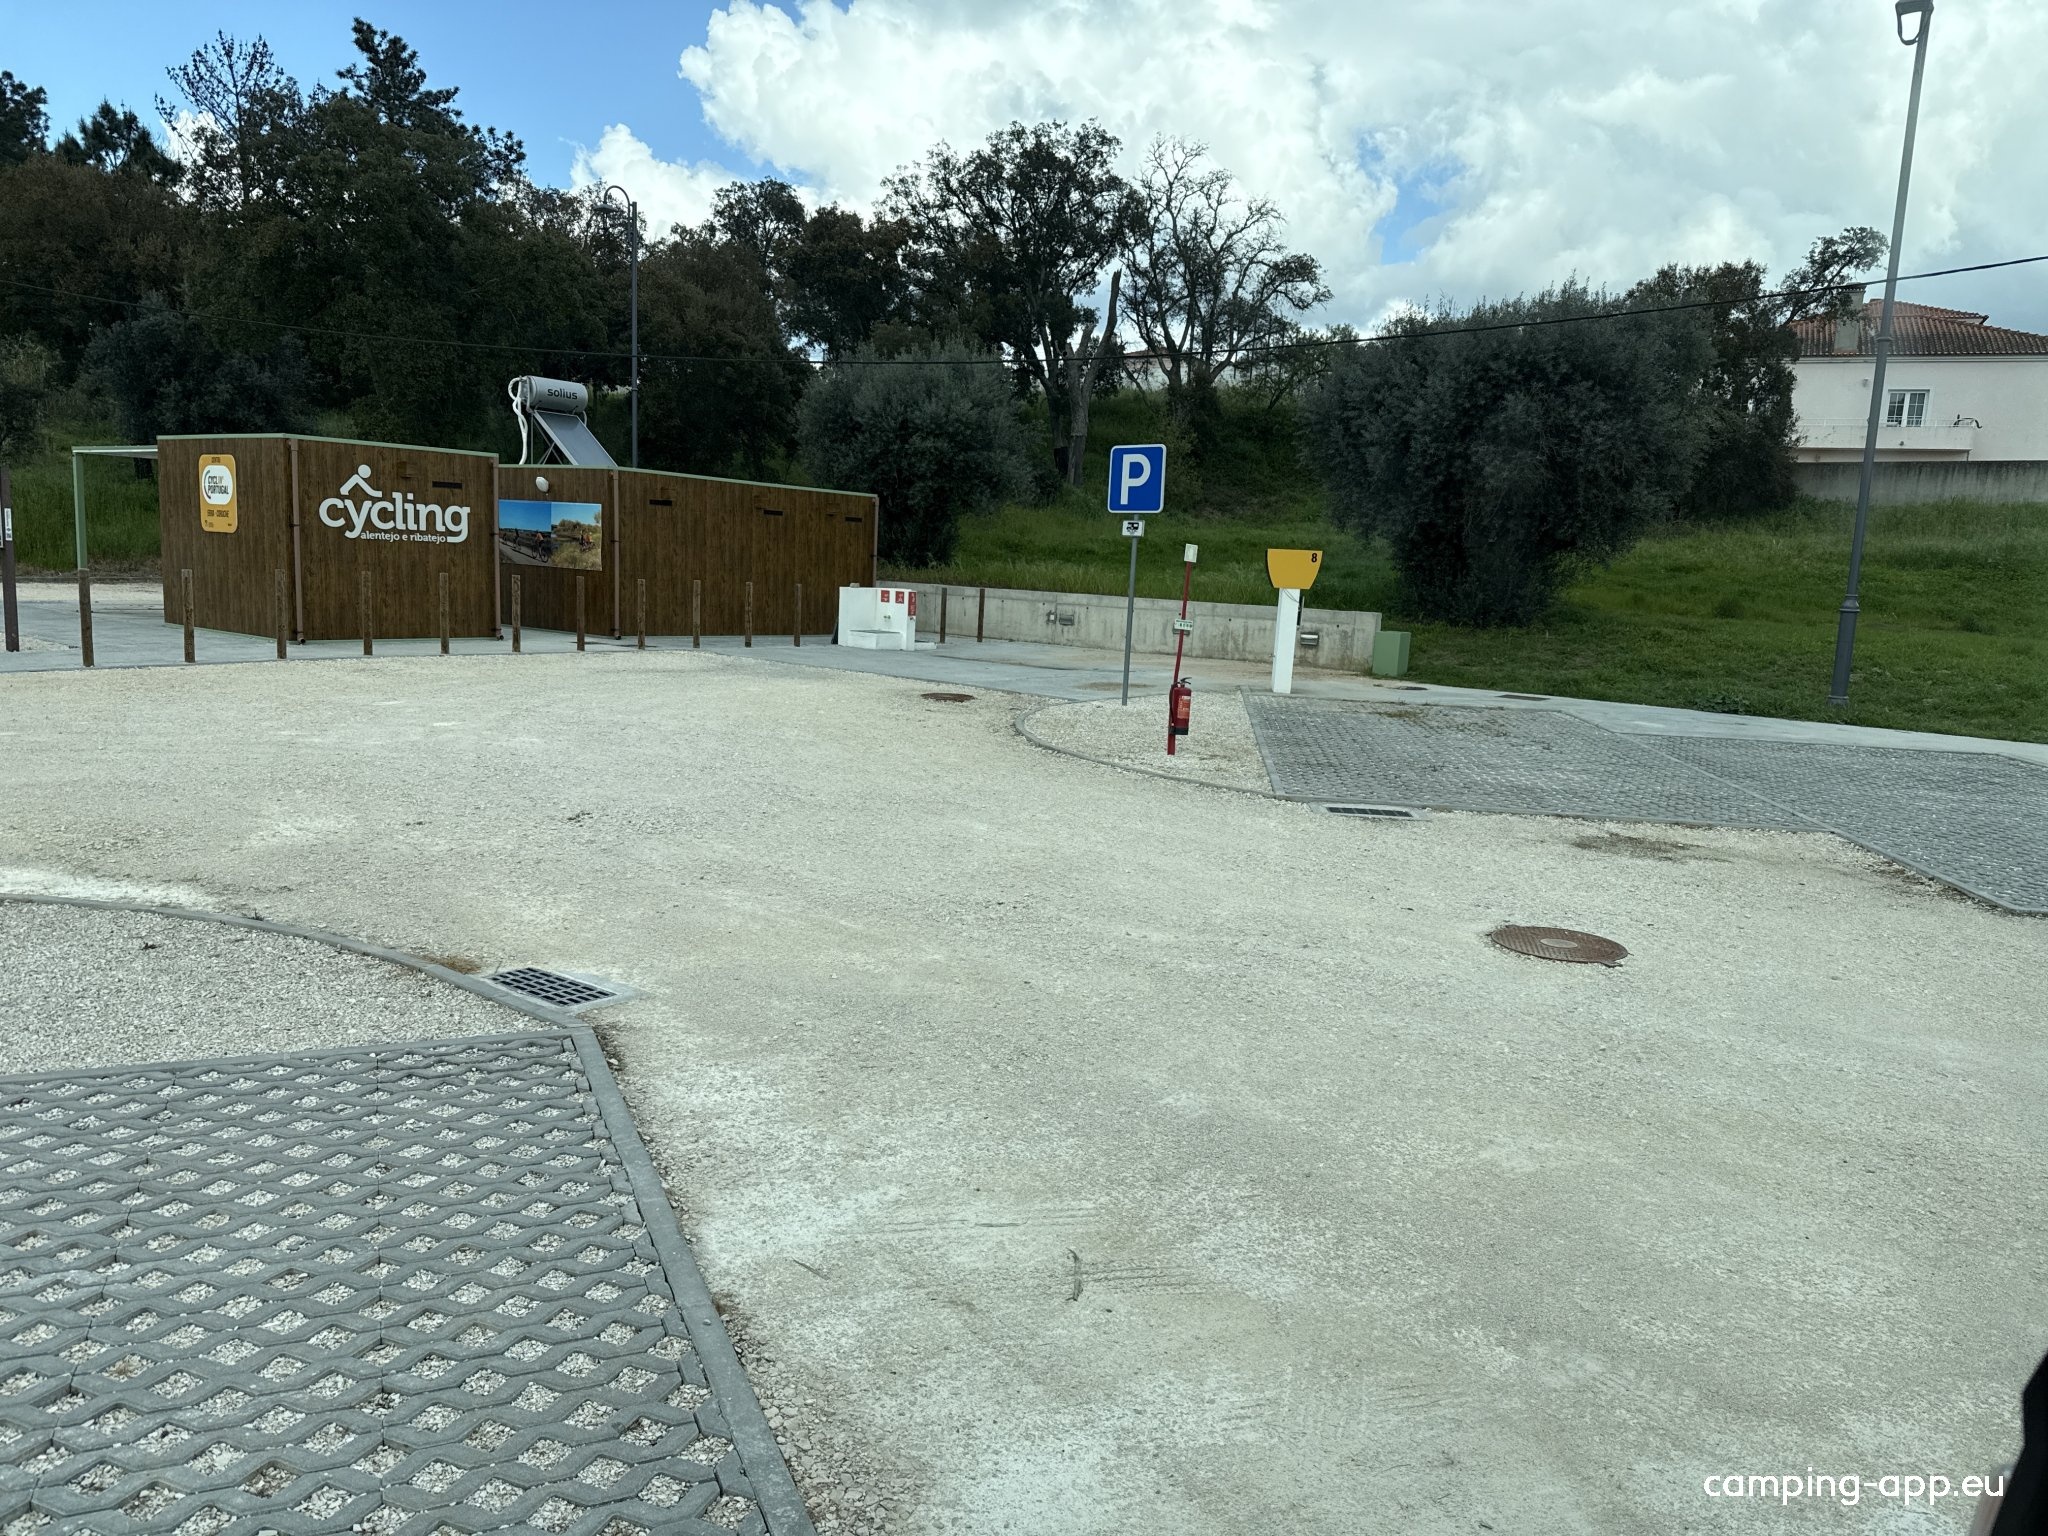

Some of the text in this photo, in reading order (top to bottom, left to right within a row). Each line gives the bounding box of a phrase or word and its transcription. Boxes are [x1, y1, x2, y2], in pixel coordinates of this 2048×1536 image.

[547, 388, 578, 400] solius
[1120, 453, 1151, 505] P
[208, 485, 229, 495] PORTUGAL
[319, 491, 471, 543] cycling
[360, 530, 400, 543] alentejo
[410, 534, 446, 544] ribatejo
[1311, 552, 1318, 563] 8
